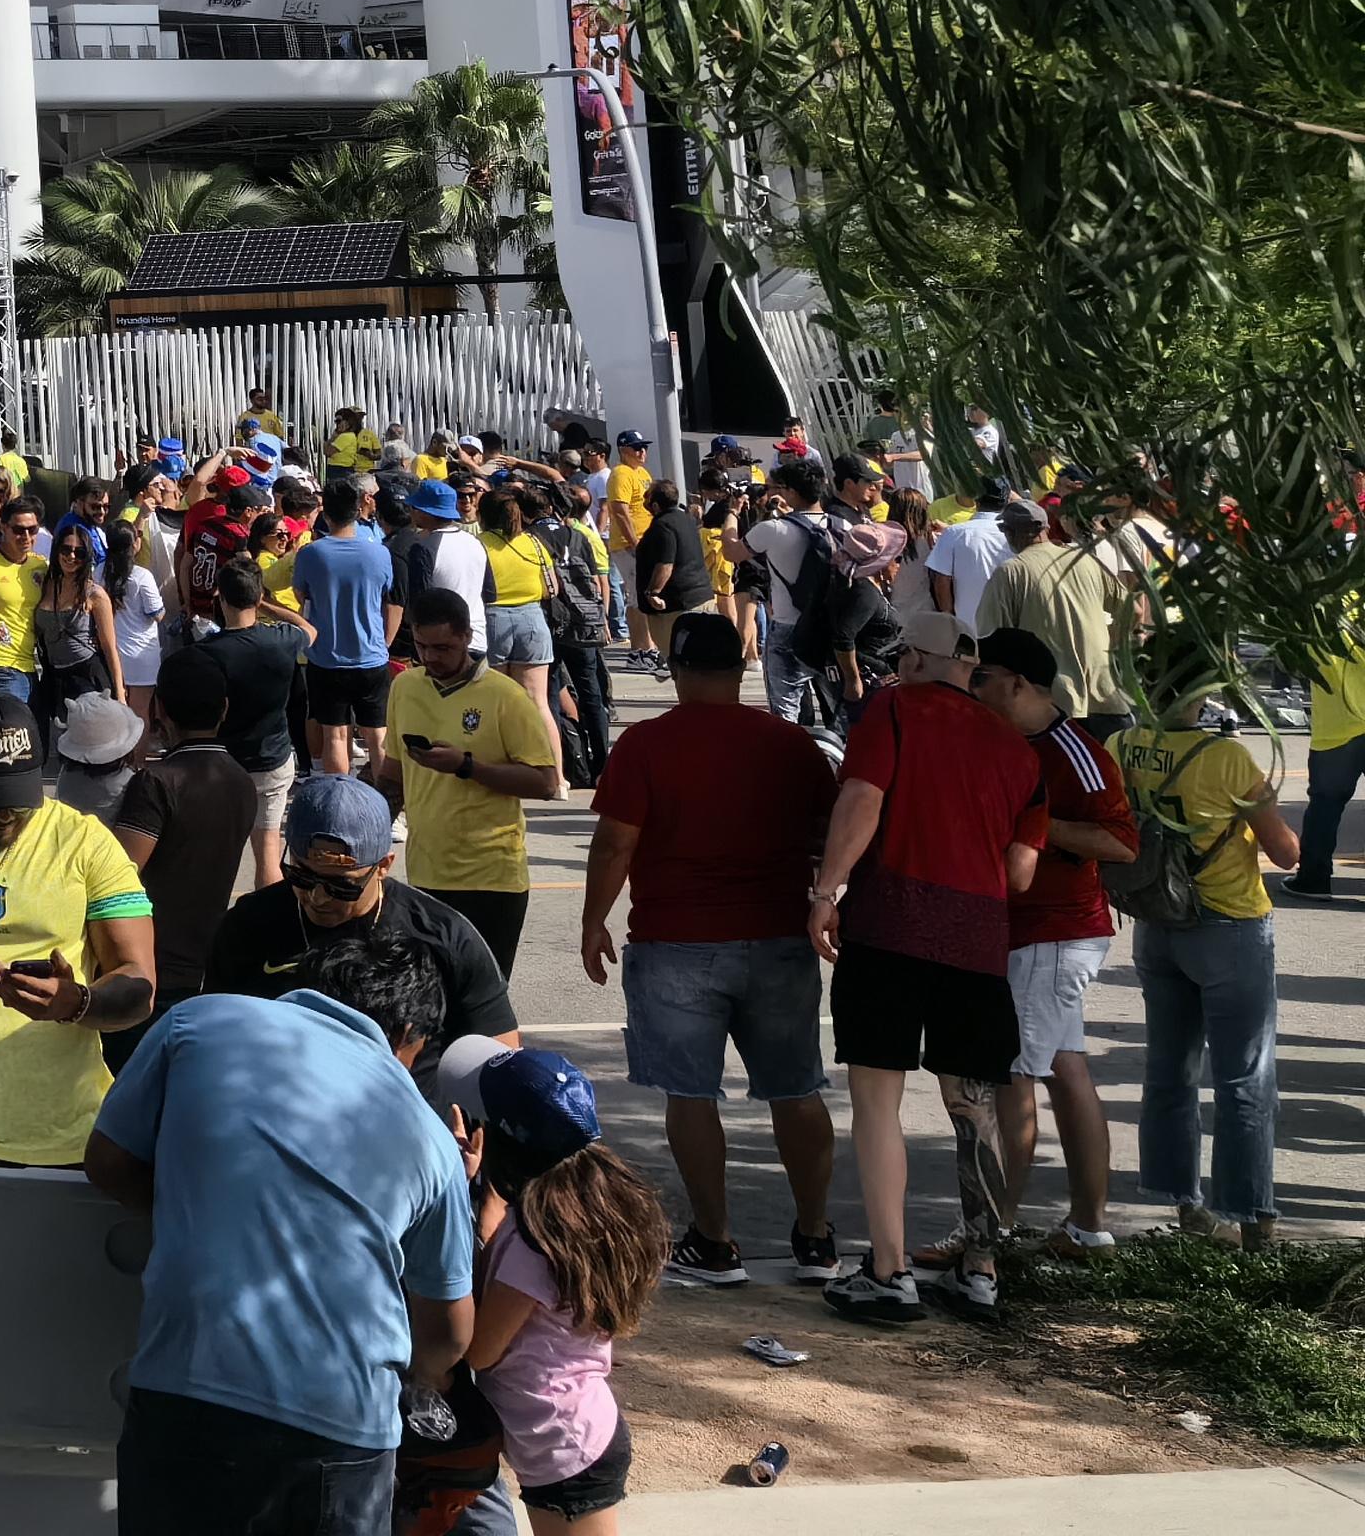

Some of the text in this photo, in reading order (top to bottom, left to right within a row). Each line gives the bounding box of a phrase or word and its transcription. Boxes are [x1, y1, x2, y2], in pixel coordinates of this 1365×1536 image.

[684, 137, 699, 196] ENTRY
[116, 315, 176, 326] Hyundai Home
